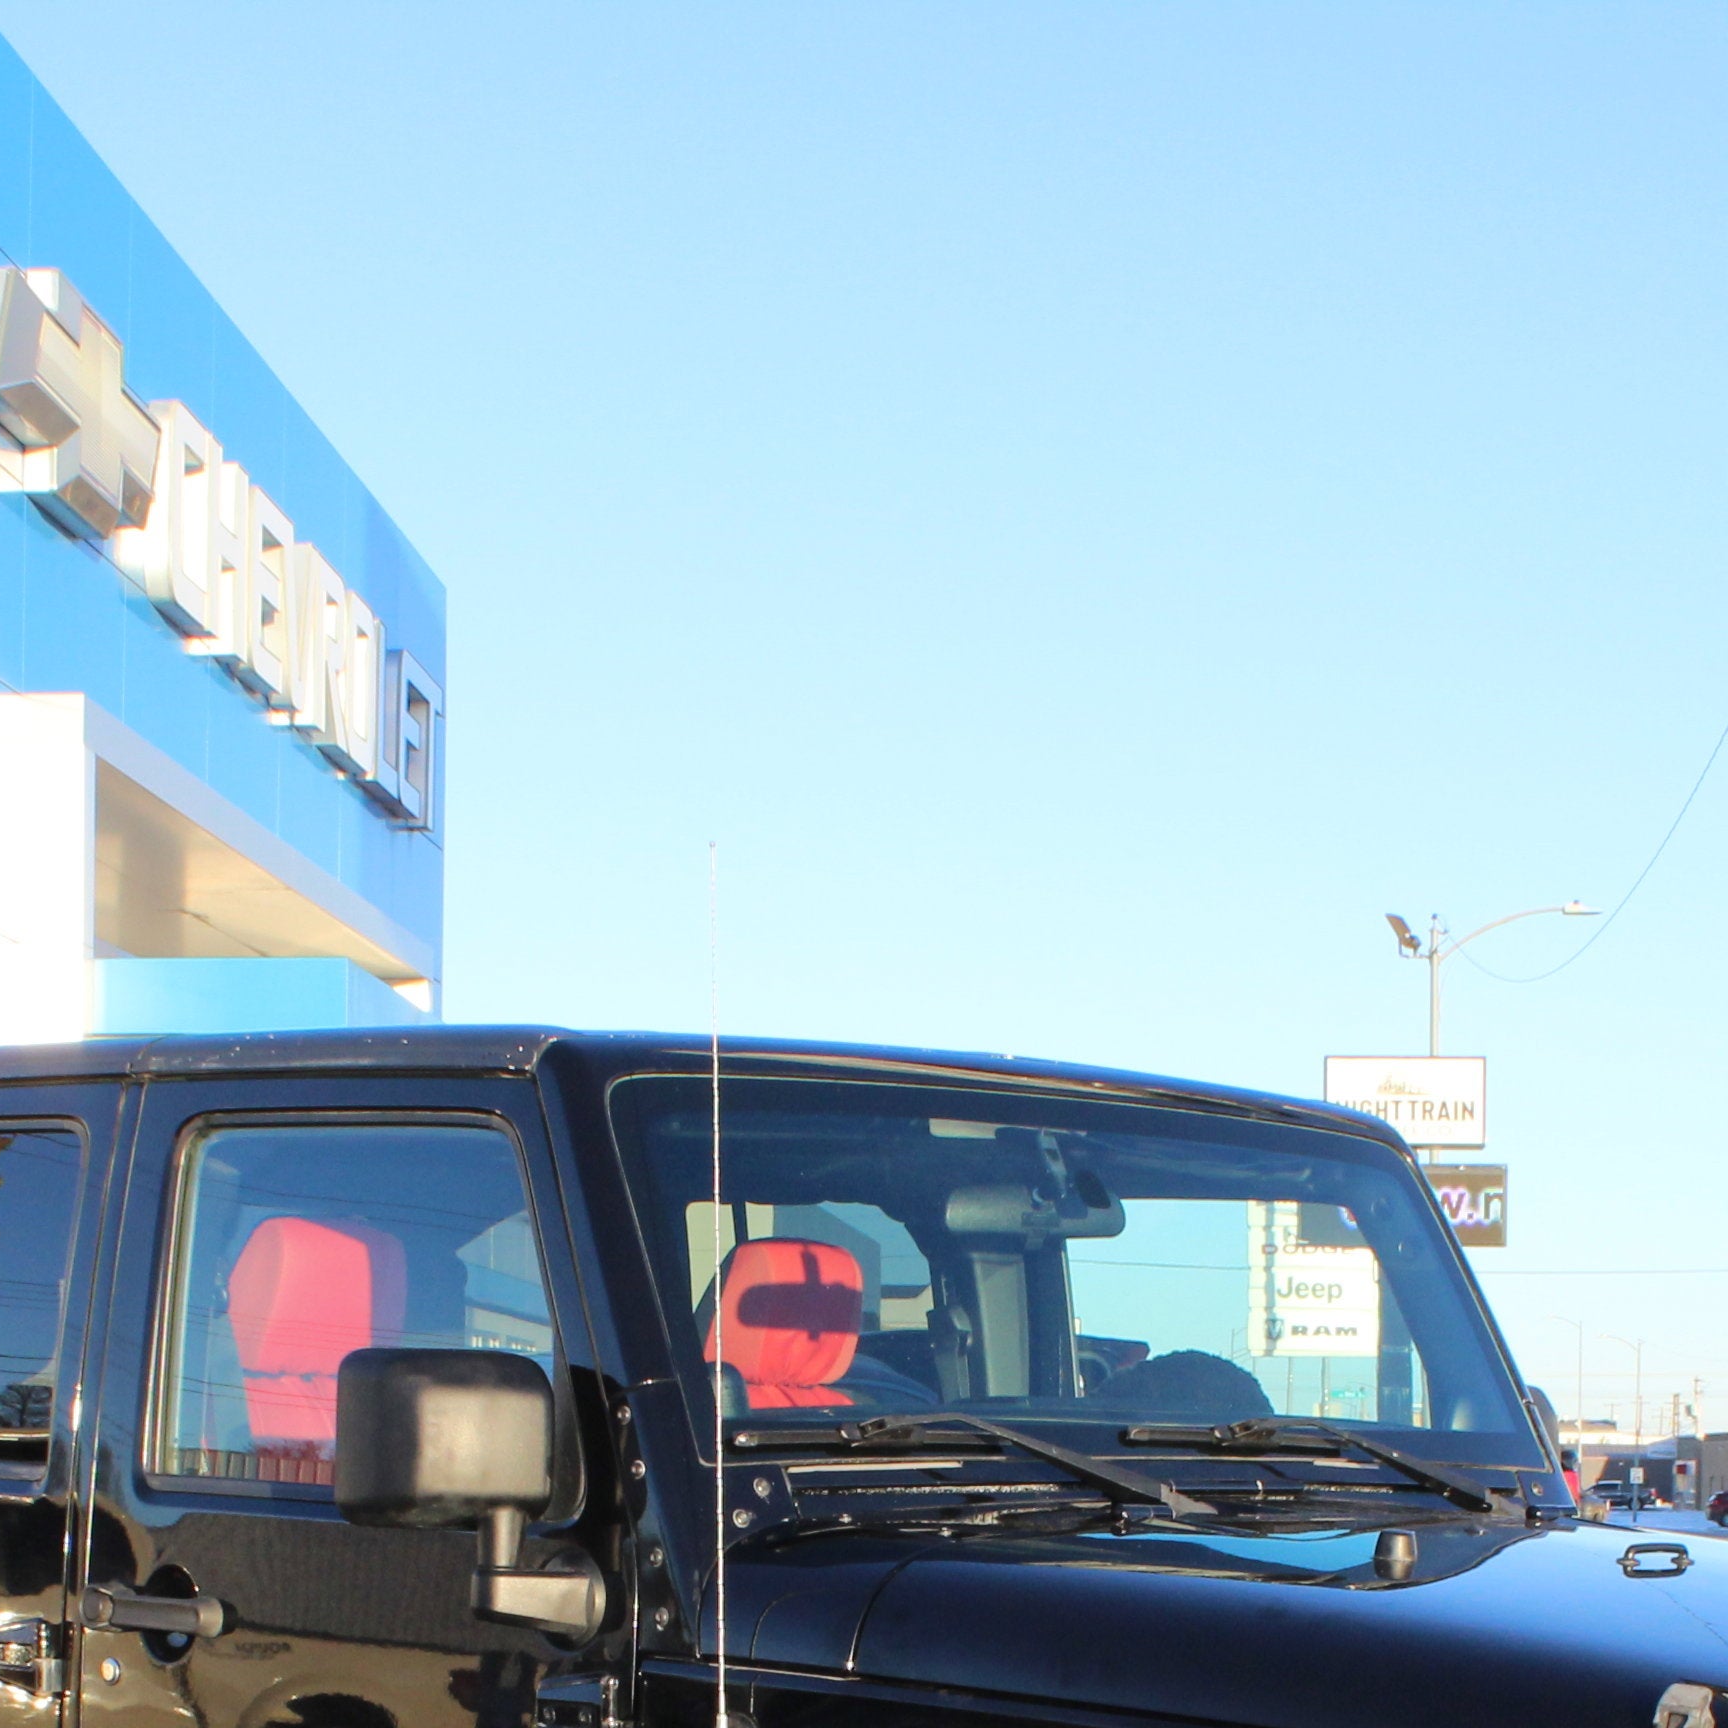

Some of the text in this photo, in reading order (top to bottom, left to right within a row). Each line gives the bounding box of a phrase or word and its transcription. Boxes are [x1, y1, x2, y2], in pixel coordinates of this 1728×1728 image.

[142, 400, 444, 831] CHEVROLET
[1408, 1100, 1475, 1121] TRAIN
[1276, 1276, 1343, 1304] Jeep
[1290, 1325, 1358, 1336] RAM
